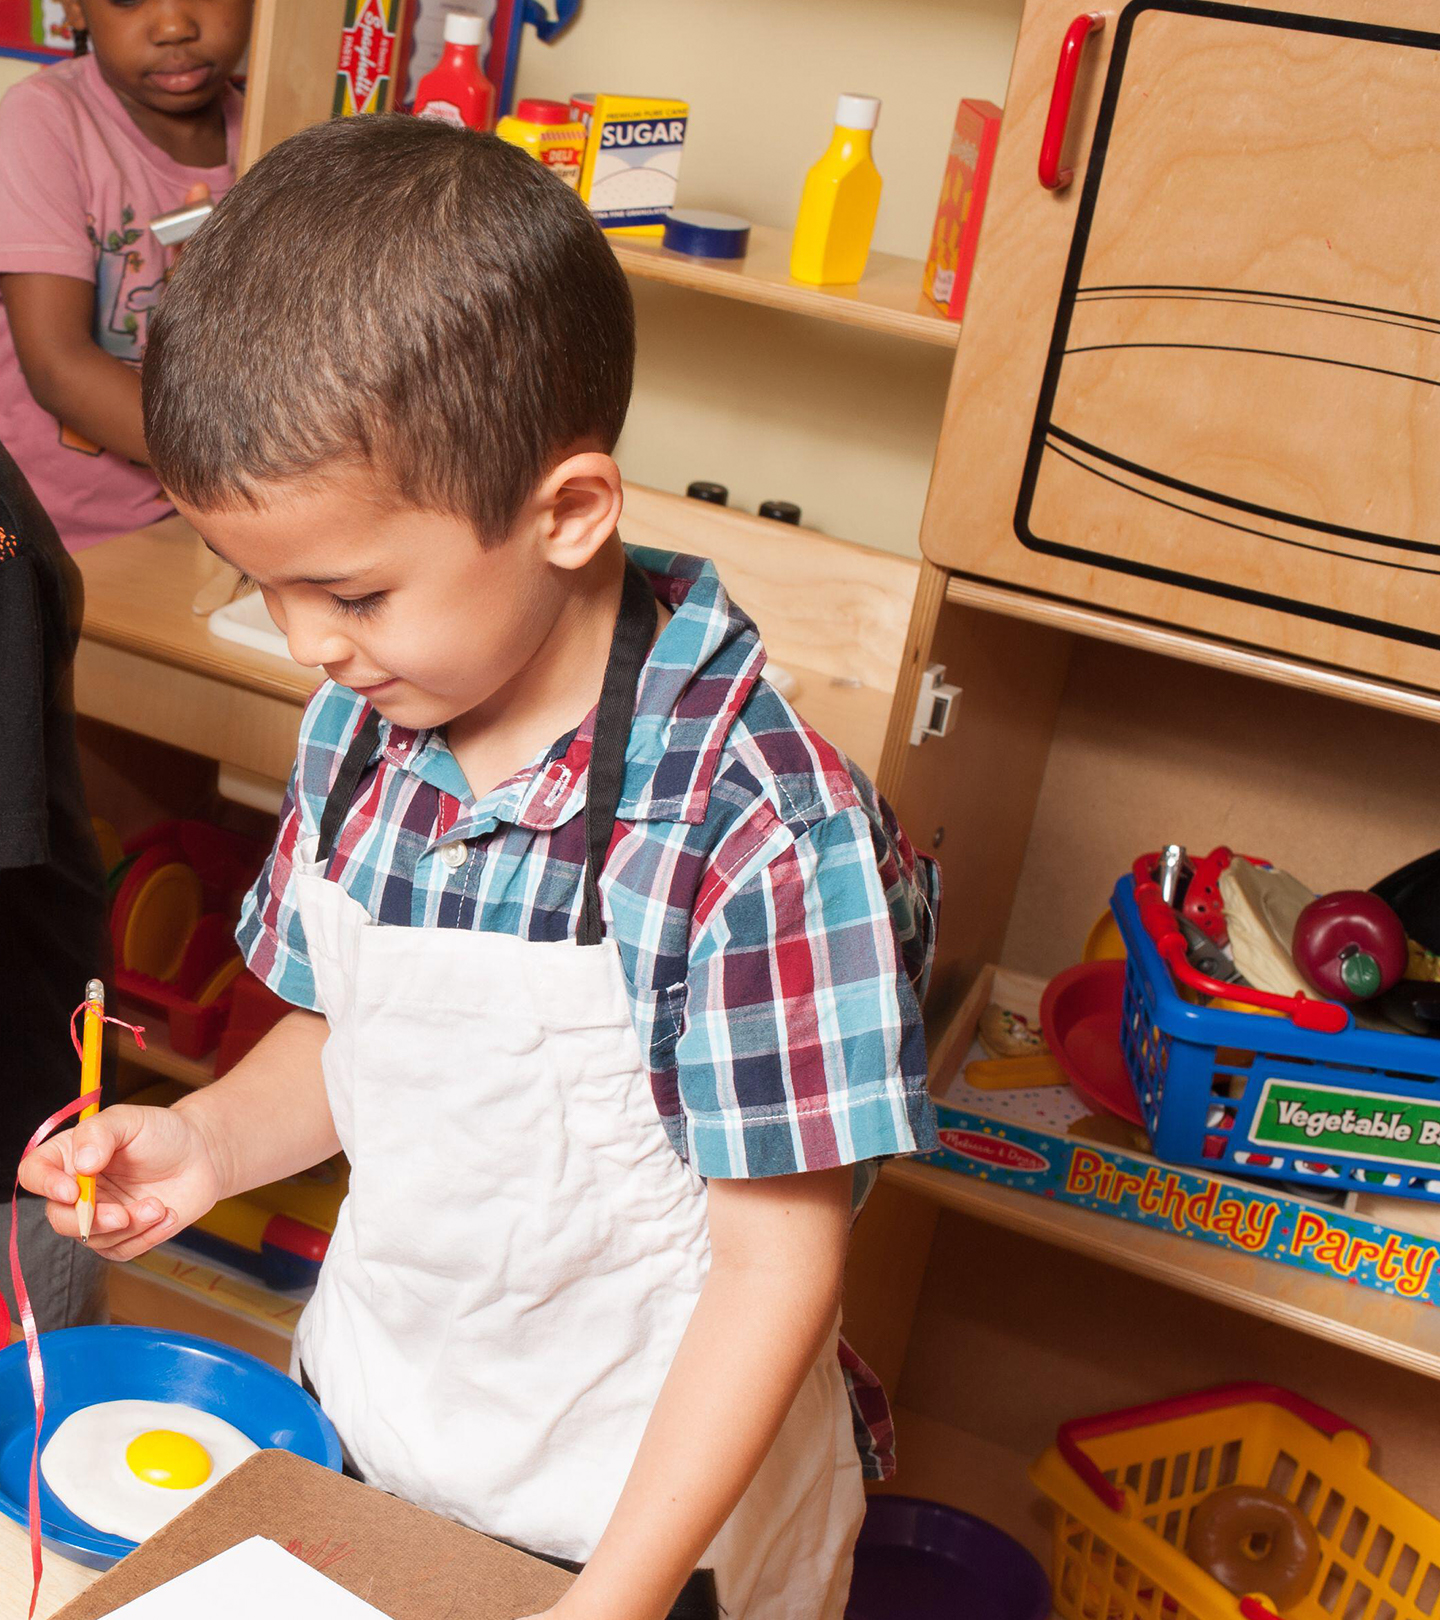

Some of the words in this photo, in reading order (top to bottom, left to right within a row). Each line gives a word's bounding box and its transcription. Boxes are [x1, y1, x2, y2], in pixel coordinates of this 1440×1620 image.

[353, 11, 386, 97] Spaghetti
[602, 121, 684, 147] SUGAR
[1276, 1098, 1412, 1142] Vegetable
[1065, 1147, 1281, 1252] Birthday
[1290, 1211, 1438, 1298] Party
